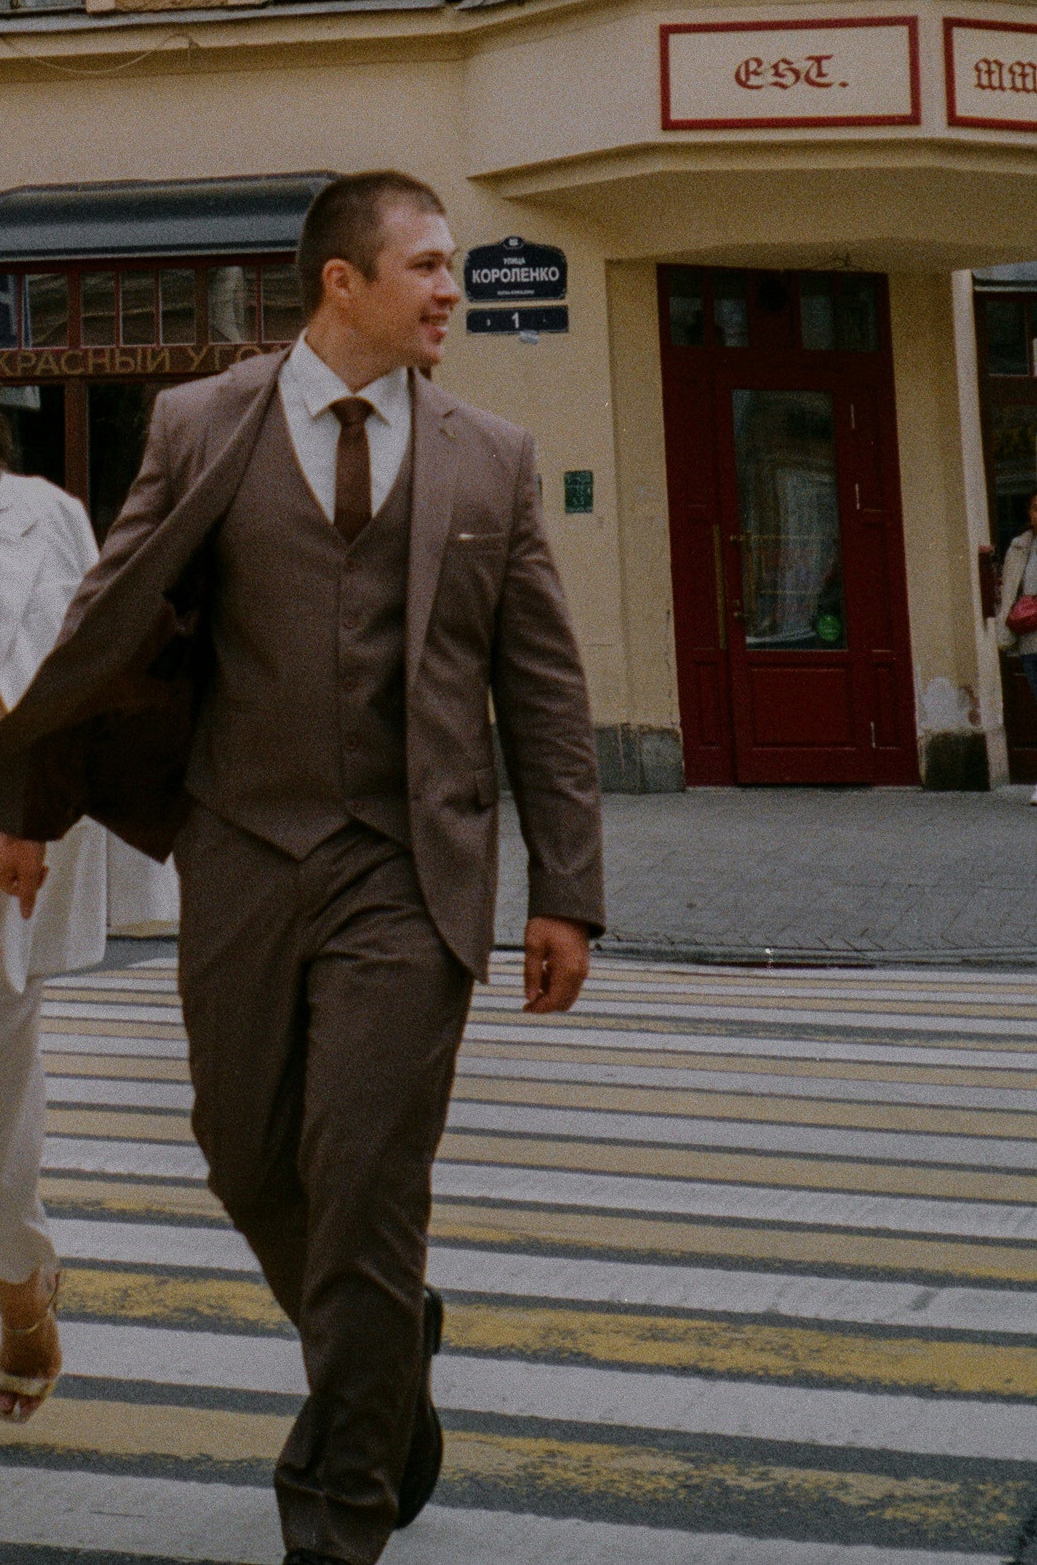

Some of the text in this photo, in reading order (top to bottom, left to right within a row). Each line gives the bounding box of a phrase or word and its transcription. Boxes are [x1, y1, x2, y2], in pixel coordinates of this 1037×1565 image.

[734, 54, 850, 90] EST.
[503, 257, 526, 266] УЛИЦА
[472, 266, 560, 283] КОРОЛЕНКО
[511, 311, 520, 329] 1
[186, 344, 280, 372] УГО
